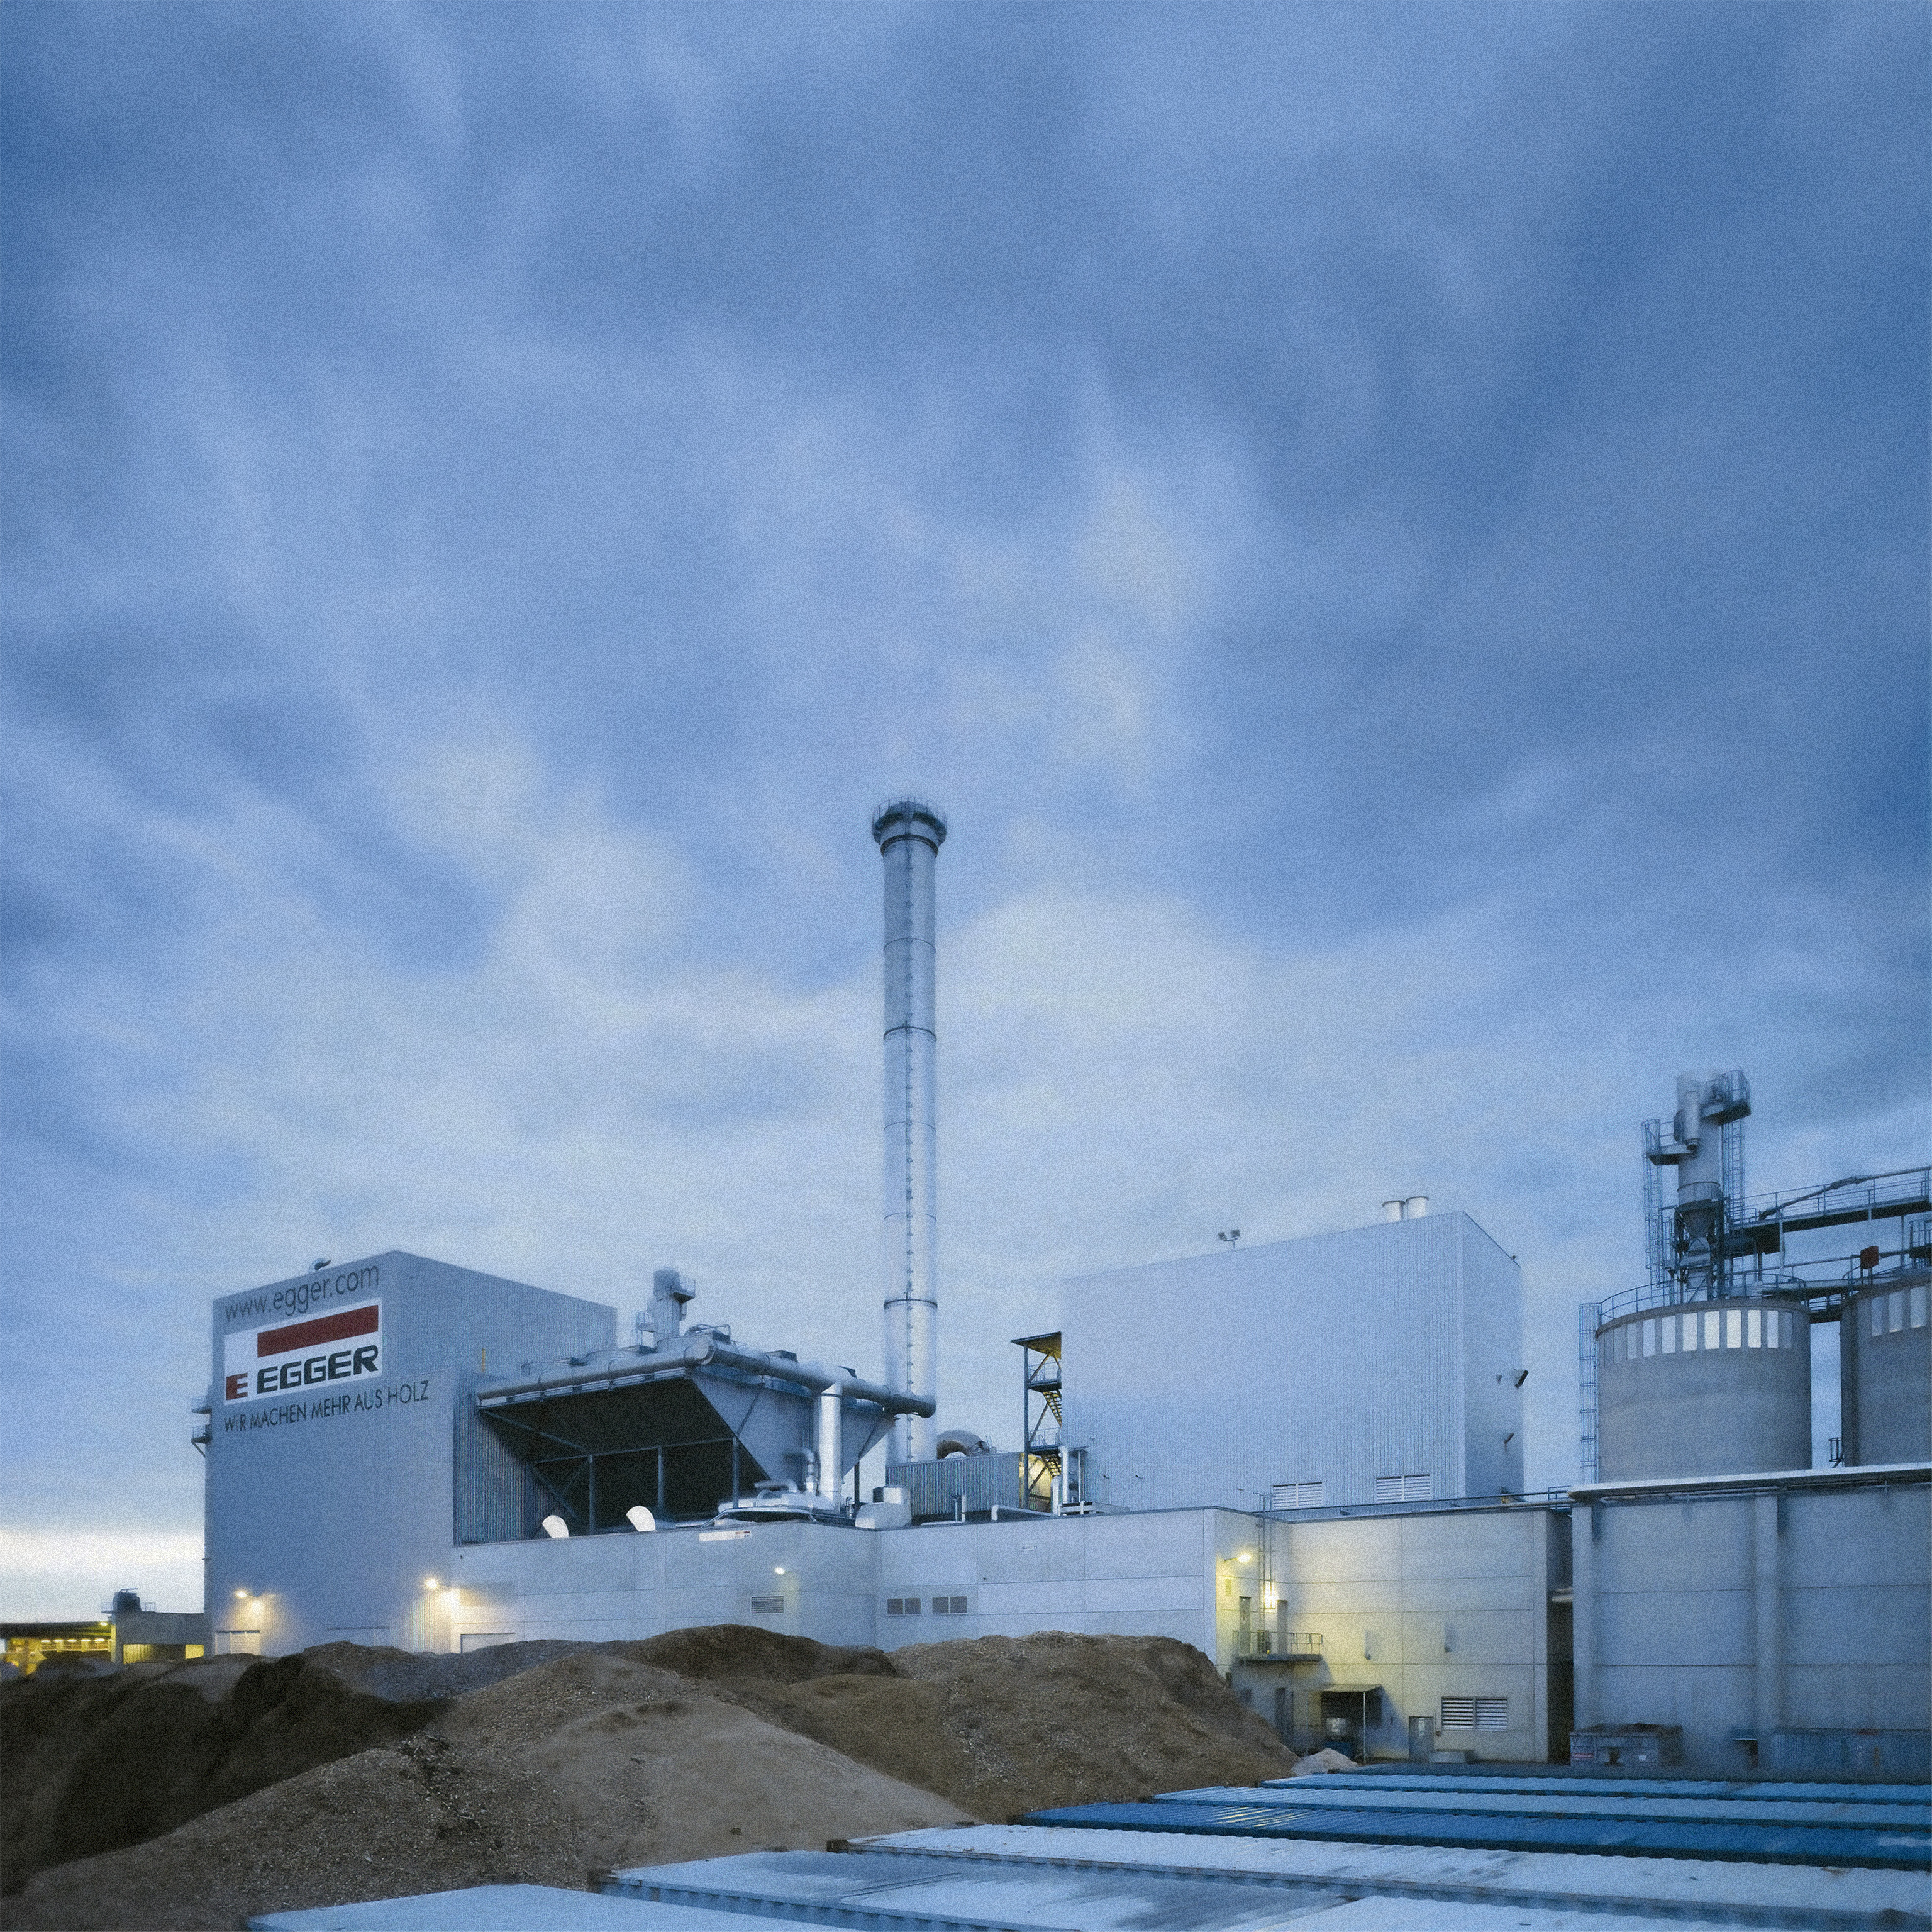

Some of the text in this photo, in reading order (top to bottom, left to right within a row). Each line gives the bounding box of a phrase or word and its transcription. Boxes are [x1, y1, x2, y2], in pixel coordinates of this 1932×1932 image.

[225, 1265, 379, 1321] www.egger.com
[257, 1345, 379, 1394] EGGER
[224, 1380, 430, 1432] WIR MACHEN MEHR AUS HOLZ
